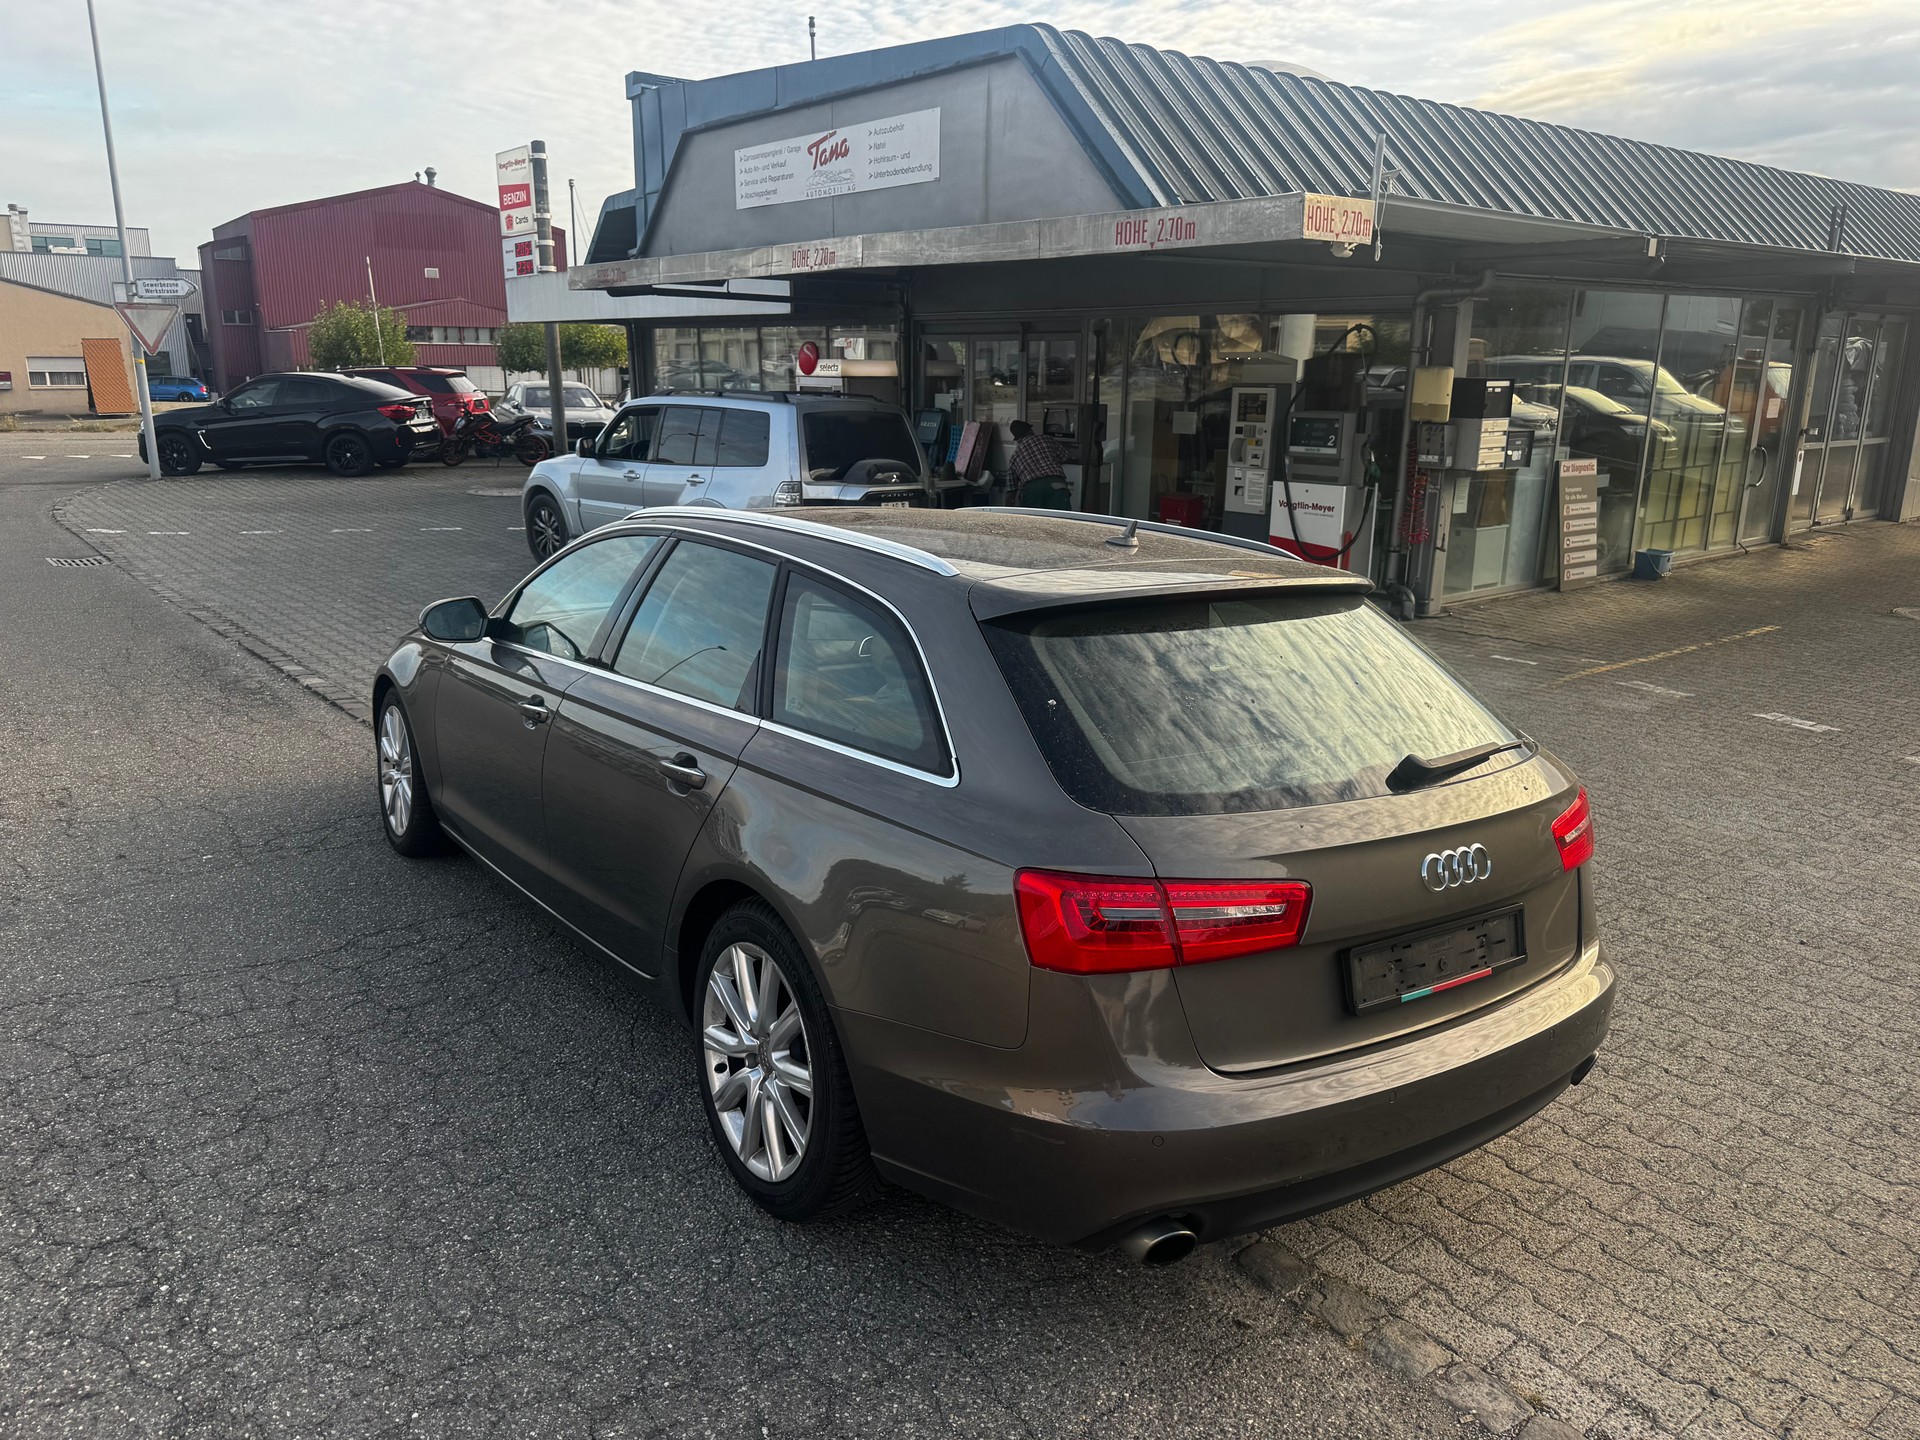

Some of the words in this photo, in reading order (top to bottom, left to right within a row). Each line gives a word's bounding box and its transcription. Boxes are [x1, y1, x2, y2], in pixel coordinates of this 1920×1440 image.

[874, 122, 905, 136] Autozubehör
[787, 146, 802, 154] Garage
[807, 130, 850, 171] Tana
[874, 154, 900, 164] Hohlraum-
[900, 150, 911, 160] und
[771, 159, 787, 169] Verkauf
[874, 164, 932, 179] Unterbodenbehandlung
[744, 179, 759, 187] Service
[768, 173, 794, 183] Reparaturen
[503, 190, 527, 206] BENZIN
[744, 188, 778, 199] Abschleppdienst
[806, 186, 843, 198] AUTOMOBIL
[848, 184, 856, 192] AG
[515, 215, 529, 226] Cards
[1306, 200, 1336, 233] HÖHE
[1115, 216, 1148, 246] HÖHE
[792, 246, 810, 269] HÖHE
[820, 363, 839, 372] selecta
[1327, 434, 1335, 446] 2
[1562, 464, 1571, 473] Car
[1571, 462, 1595, 474] Diagnostic
[1278, 500, 1335, 513] Vogtlin-Meyer
[766, 934, 798, 983] KUMHO
